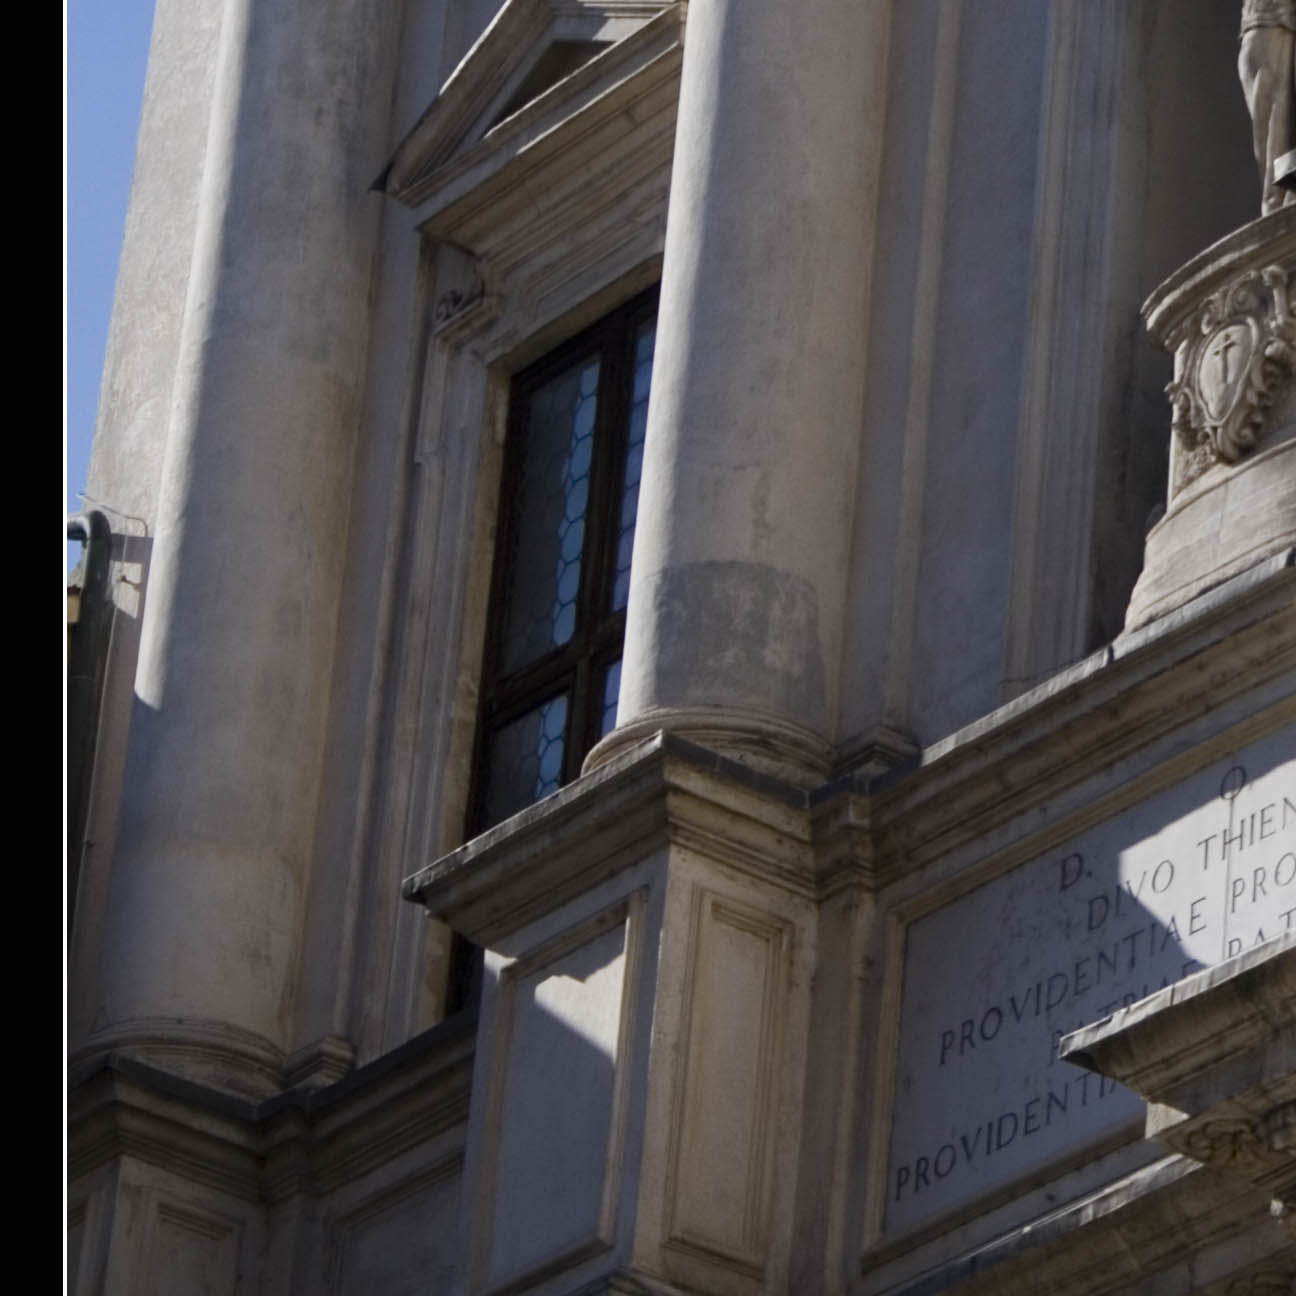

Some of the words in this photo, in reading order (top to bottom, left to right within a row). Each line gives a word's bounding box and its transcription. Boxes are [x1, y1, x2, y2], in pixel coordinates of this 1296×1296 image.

[1087, 859, 1174, 932] DIVO
[940, 897, 1207, 1065] PROVIDENTIAE
[895, 1070, 1116, 1202] PROVIDENTI
